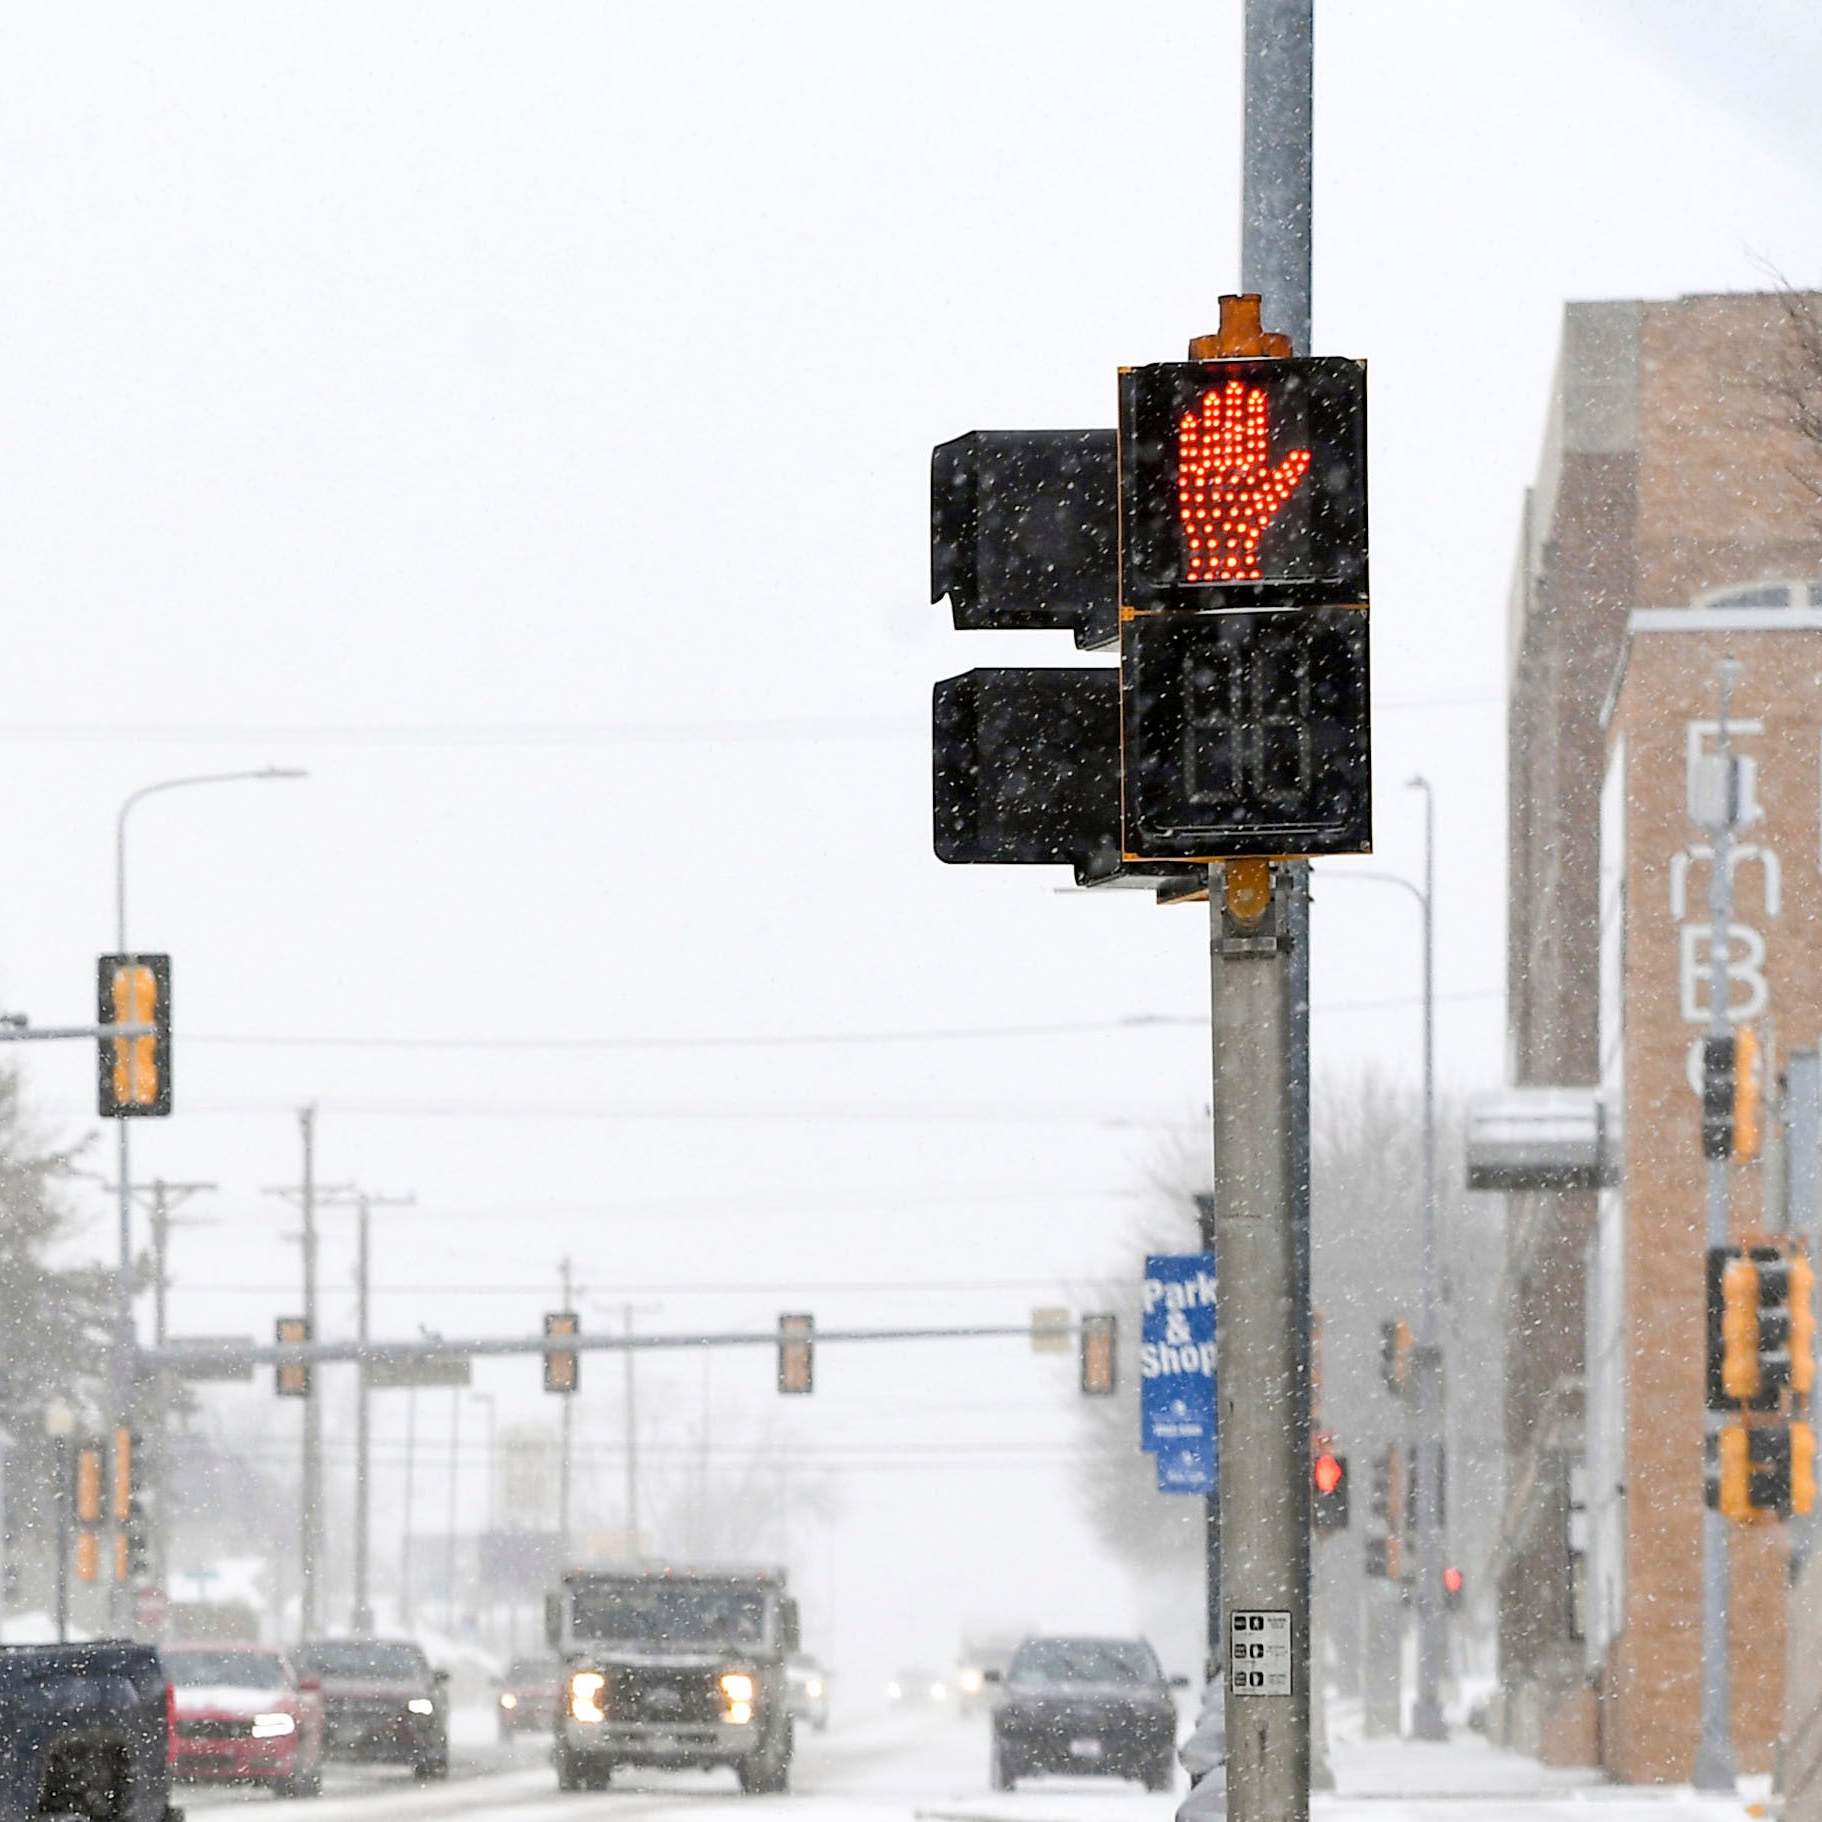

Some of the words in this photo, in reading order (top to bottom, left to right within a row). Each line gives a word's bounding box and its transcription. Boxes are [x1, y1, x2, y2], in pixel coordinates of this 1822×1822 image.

[1141, 1270, 1217, 1314] Park
[1166, 1310, 1192, 1346] &
[1140, 1340, 1217, 1378] Shop
